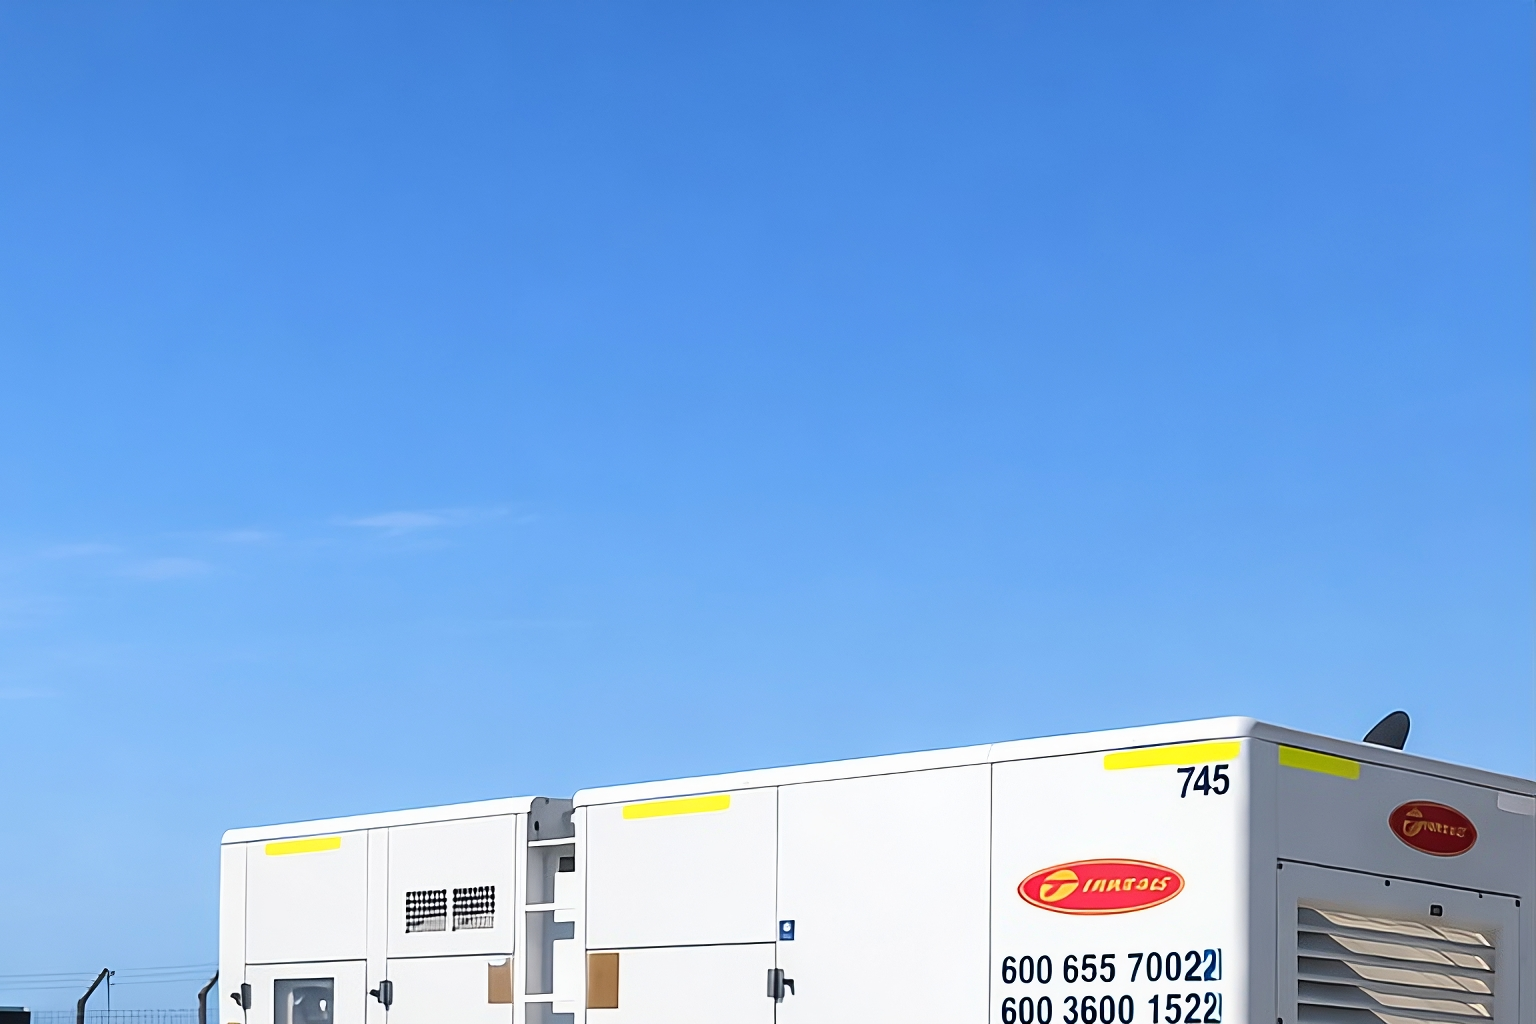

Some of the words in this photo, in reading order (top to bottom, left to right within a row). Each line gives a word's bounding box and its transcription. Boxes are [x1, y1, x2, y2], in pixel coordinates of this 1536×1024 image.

[1176, 763, 1230, 799] 745
[1001, 954, 1053, 985] 600
[1063, 953, 1116, 984] 655
[1063, 994, 1134, 1024] 3600
